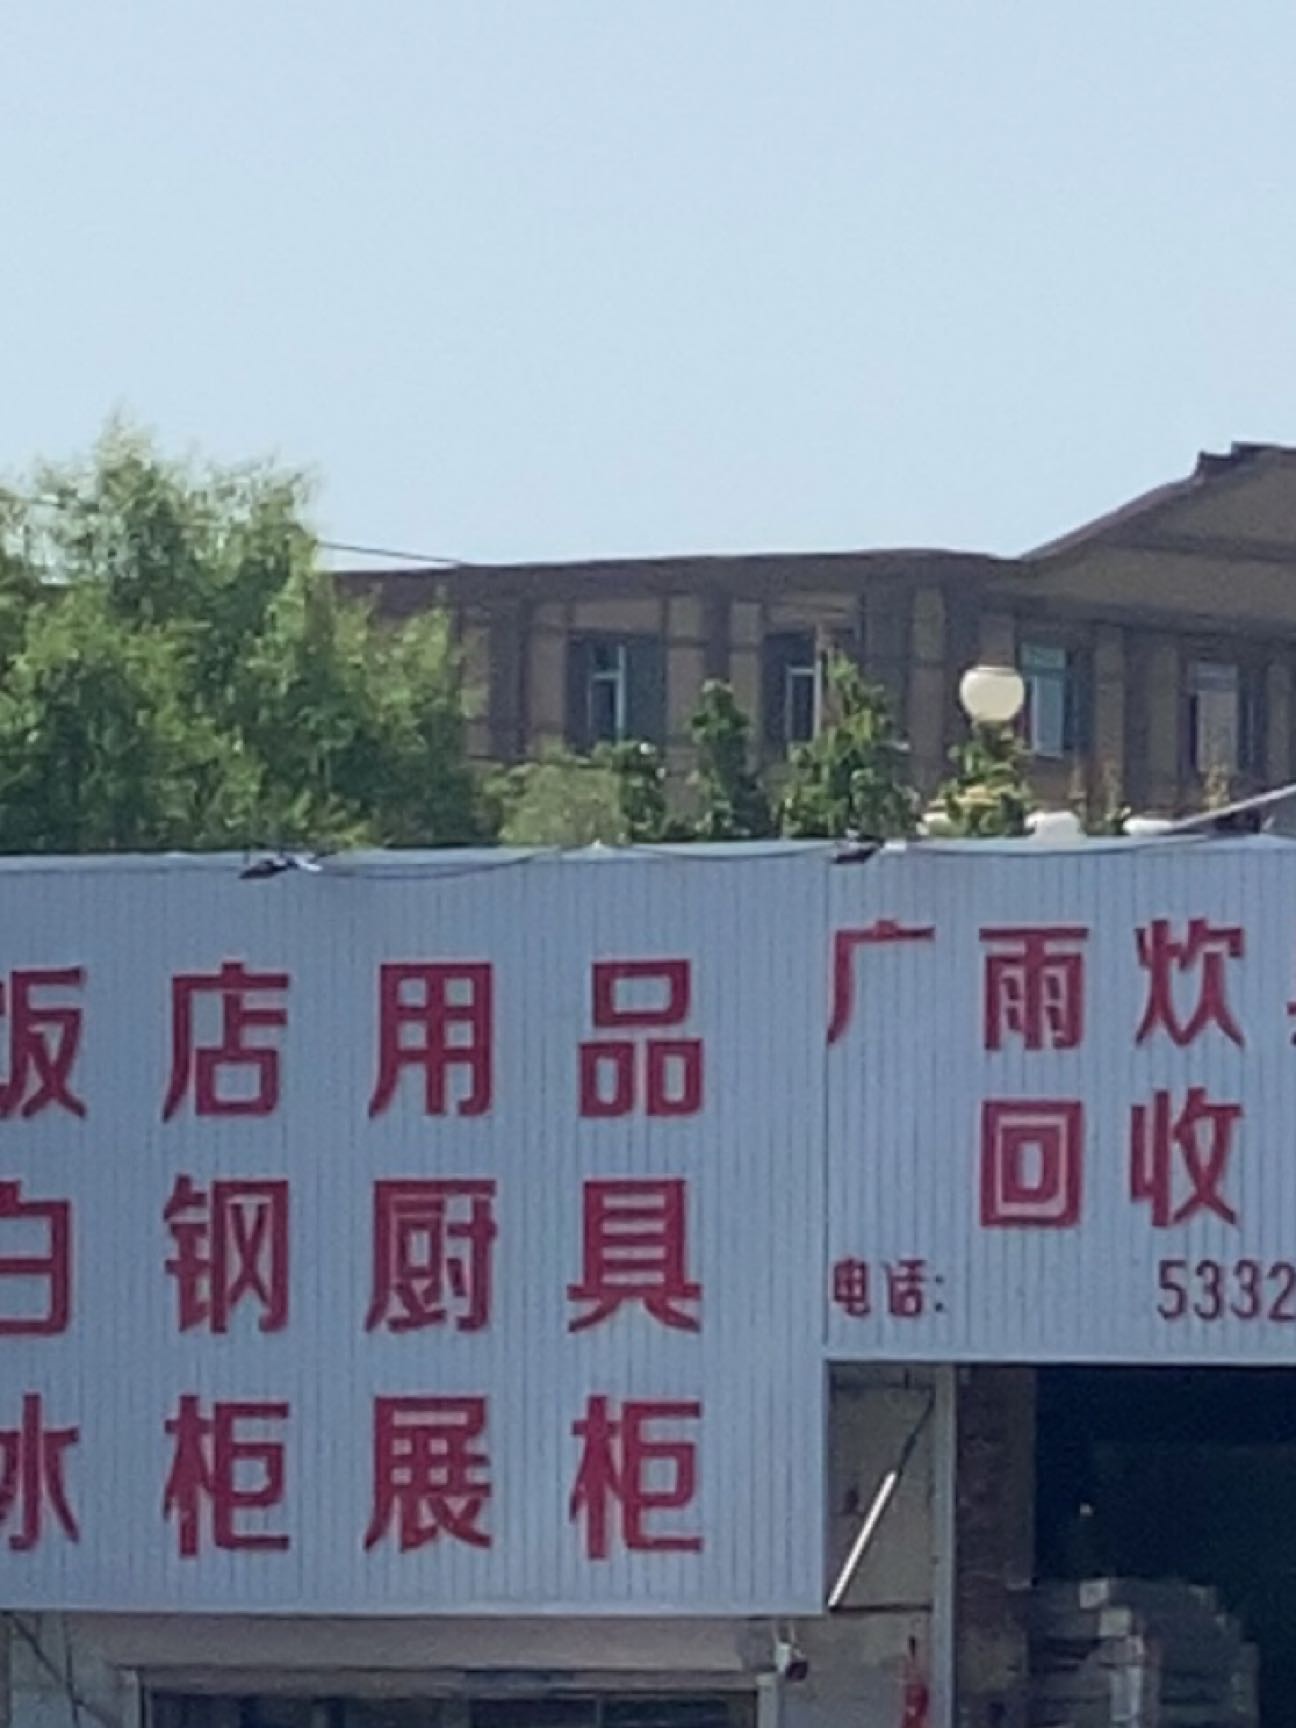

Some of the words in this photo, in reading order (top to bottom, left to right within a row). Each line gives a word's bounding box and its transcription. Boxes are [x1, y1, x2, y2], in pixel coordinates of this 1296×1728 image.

[0, 960, 704, 1120] 饭店用品
[979, 1087, 1243, 1229] 回收
[0, 1177, 703, 1335] 白钢厨具
[0, 1395, 704, 1561] 冰柜展柜
